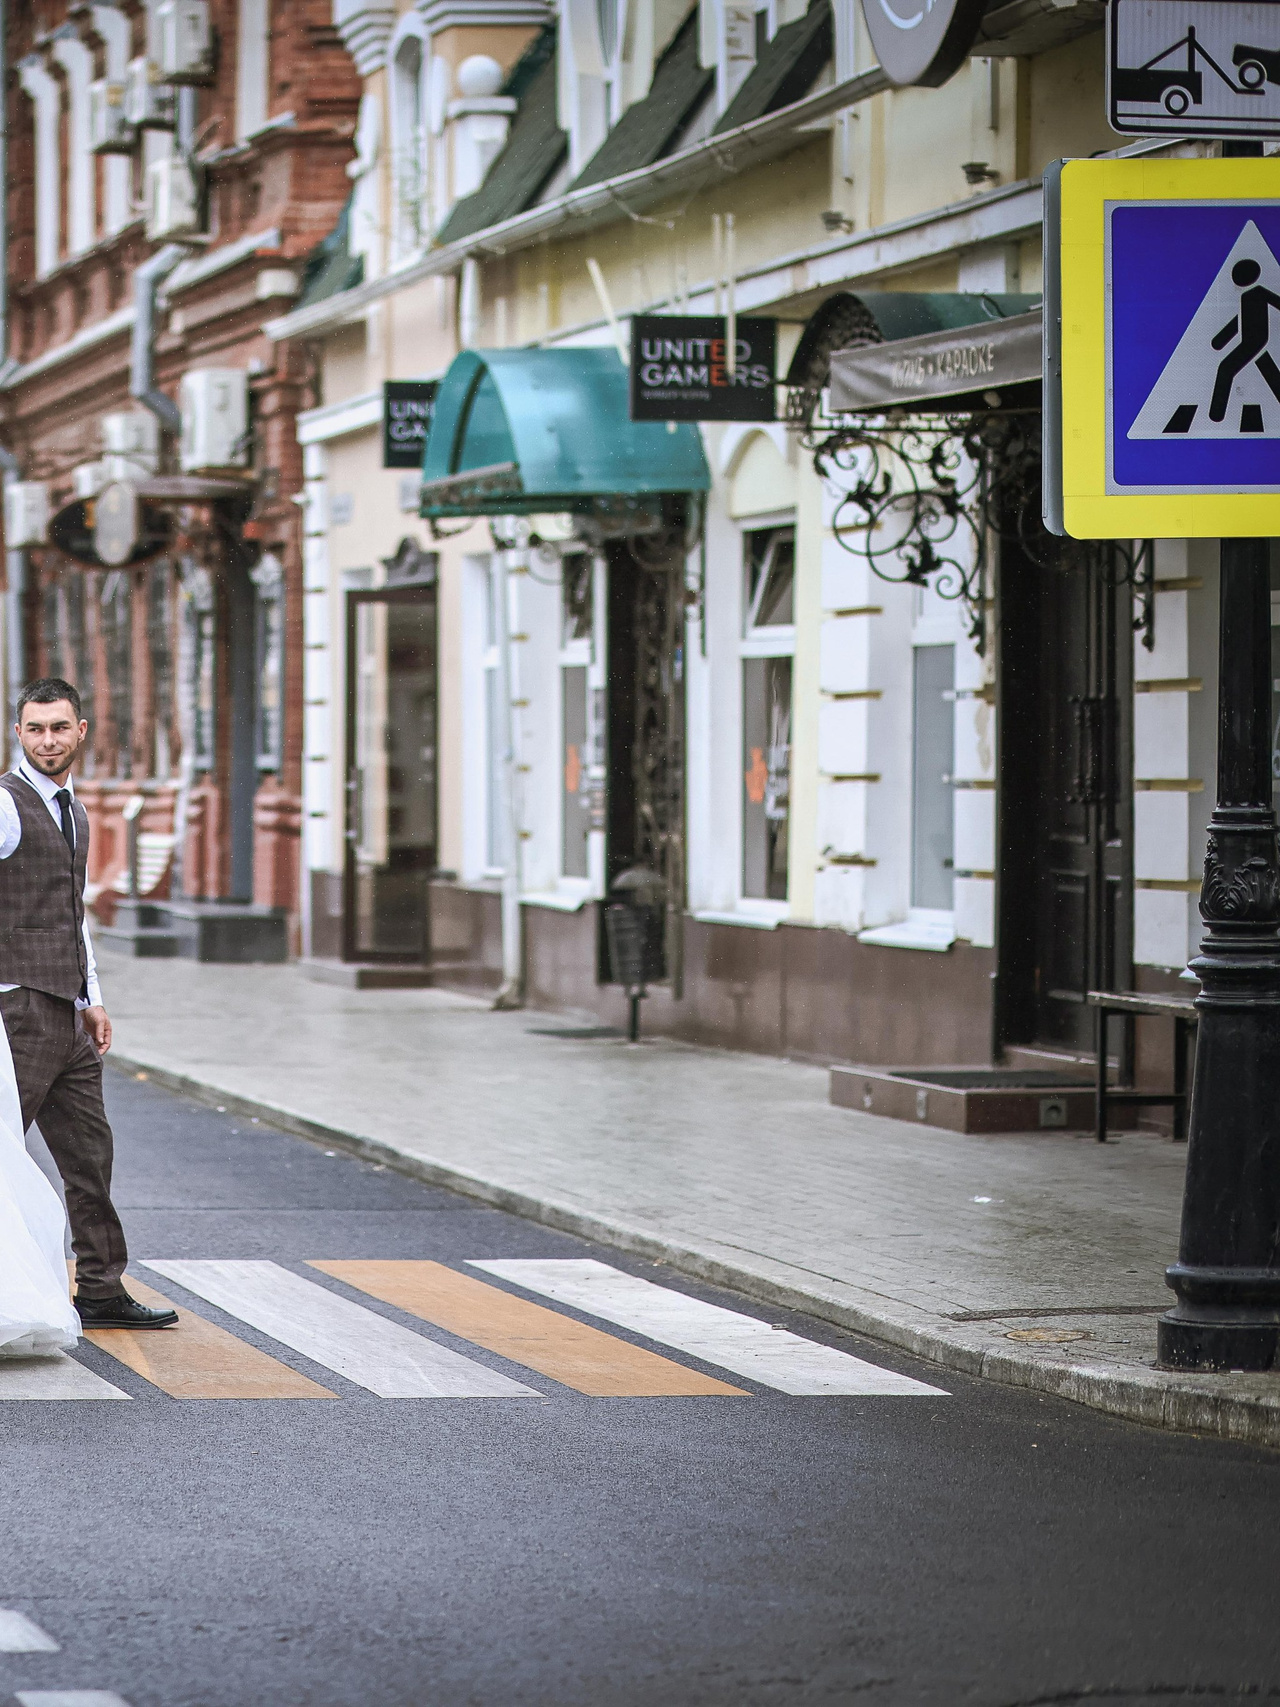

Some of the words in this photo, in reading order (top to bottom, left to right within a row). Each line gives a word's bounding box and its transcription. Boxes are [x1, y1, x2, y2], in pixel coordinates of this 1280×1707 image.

[641, 338, 752, 362] UNITED
[937, 342, 995, 380] КАРАОКЕ
[640, 362, 770, 388] GAMERS
